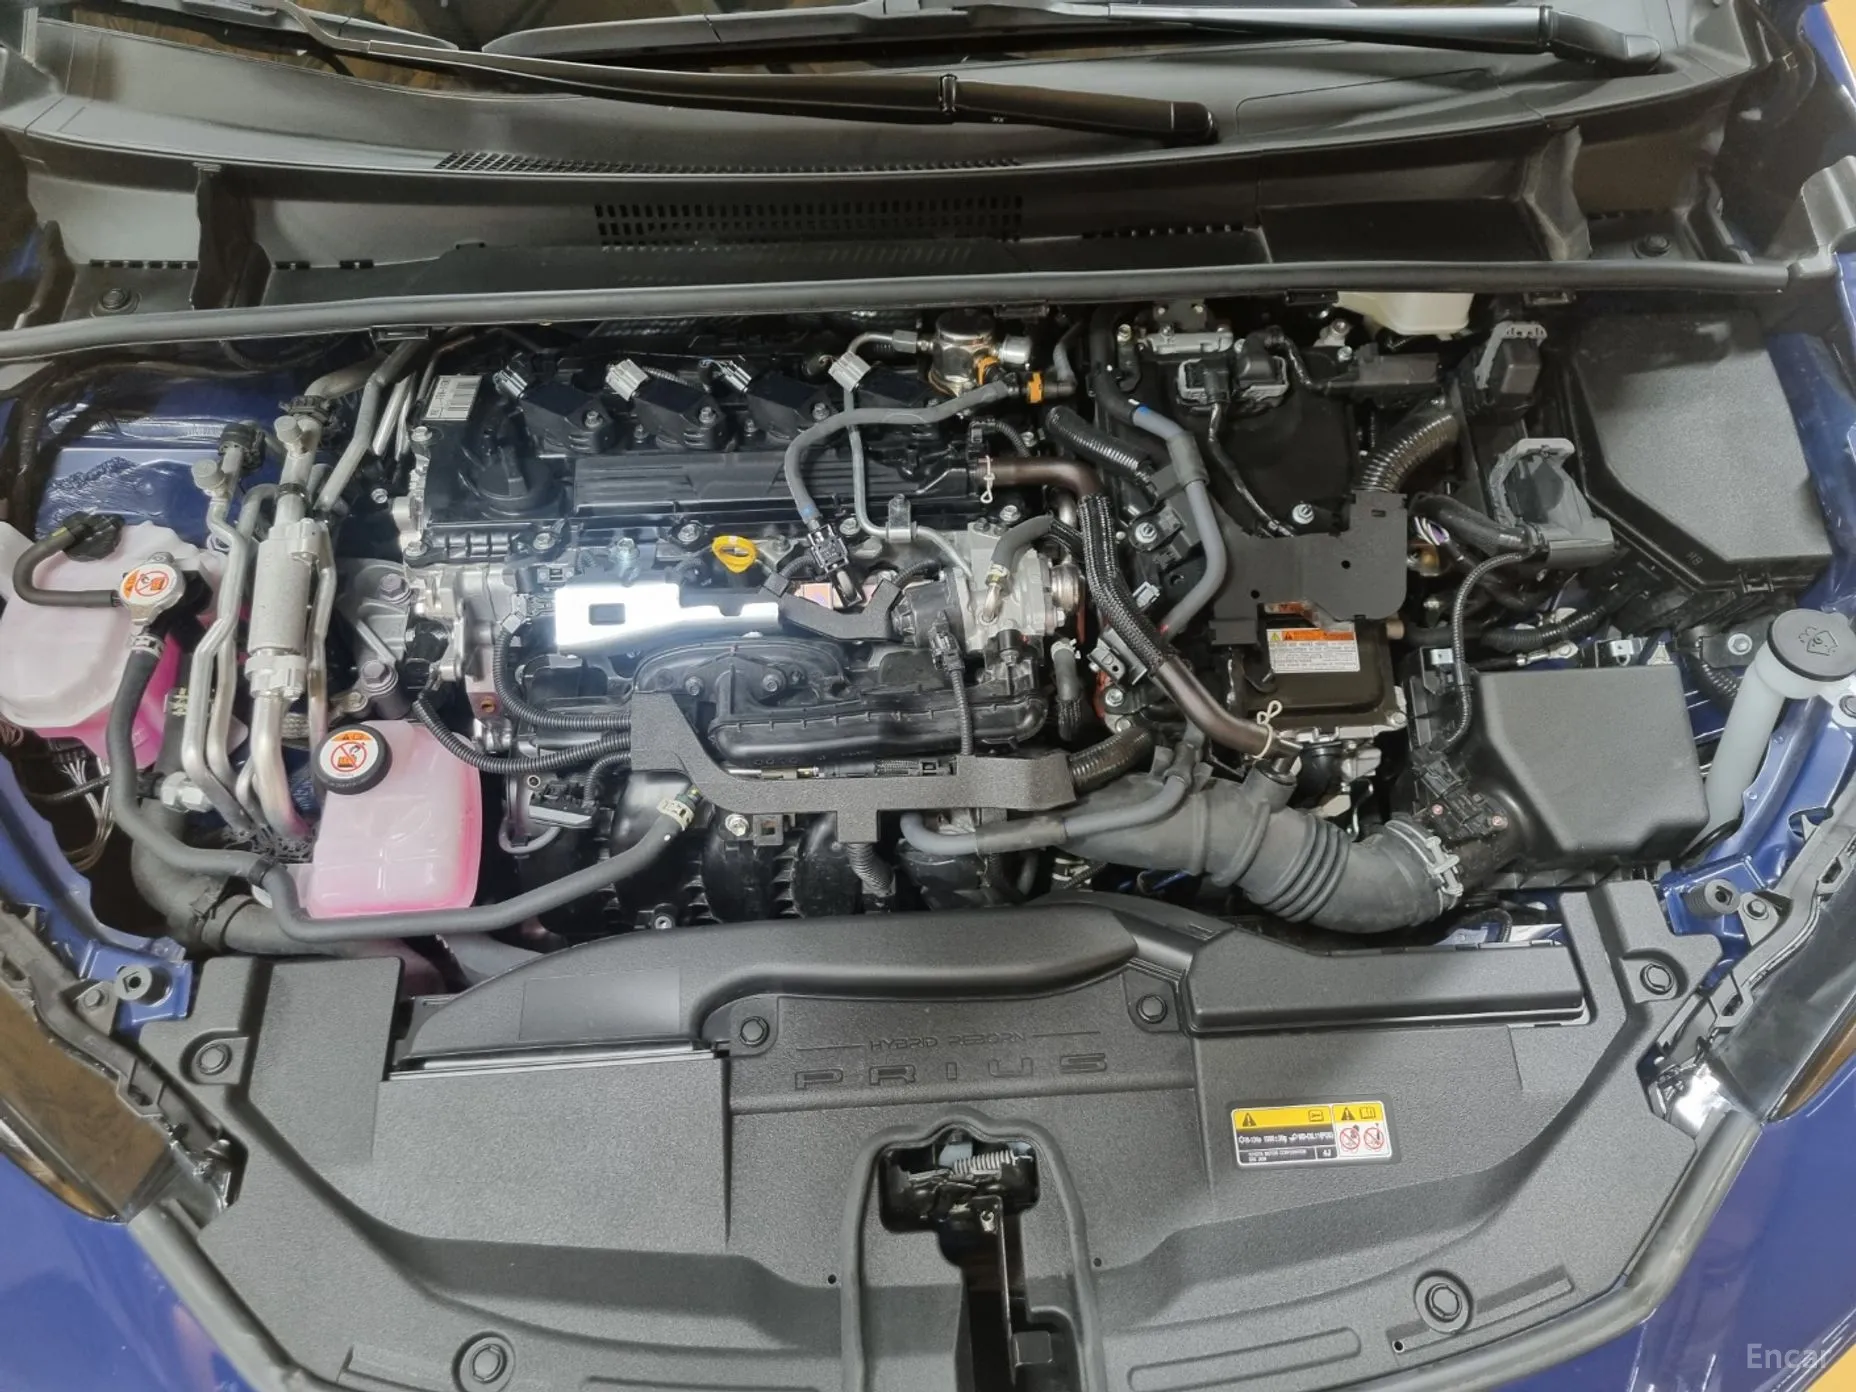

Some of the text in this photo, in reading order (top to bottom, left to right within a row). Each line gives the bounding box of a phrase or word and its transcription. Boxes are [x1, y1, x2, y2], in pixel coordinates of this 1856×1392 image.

[869, 1031, 1026, 1050] HYBRID REBORN
[795, 1052, 1107, 1090] PRIUS
